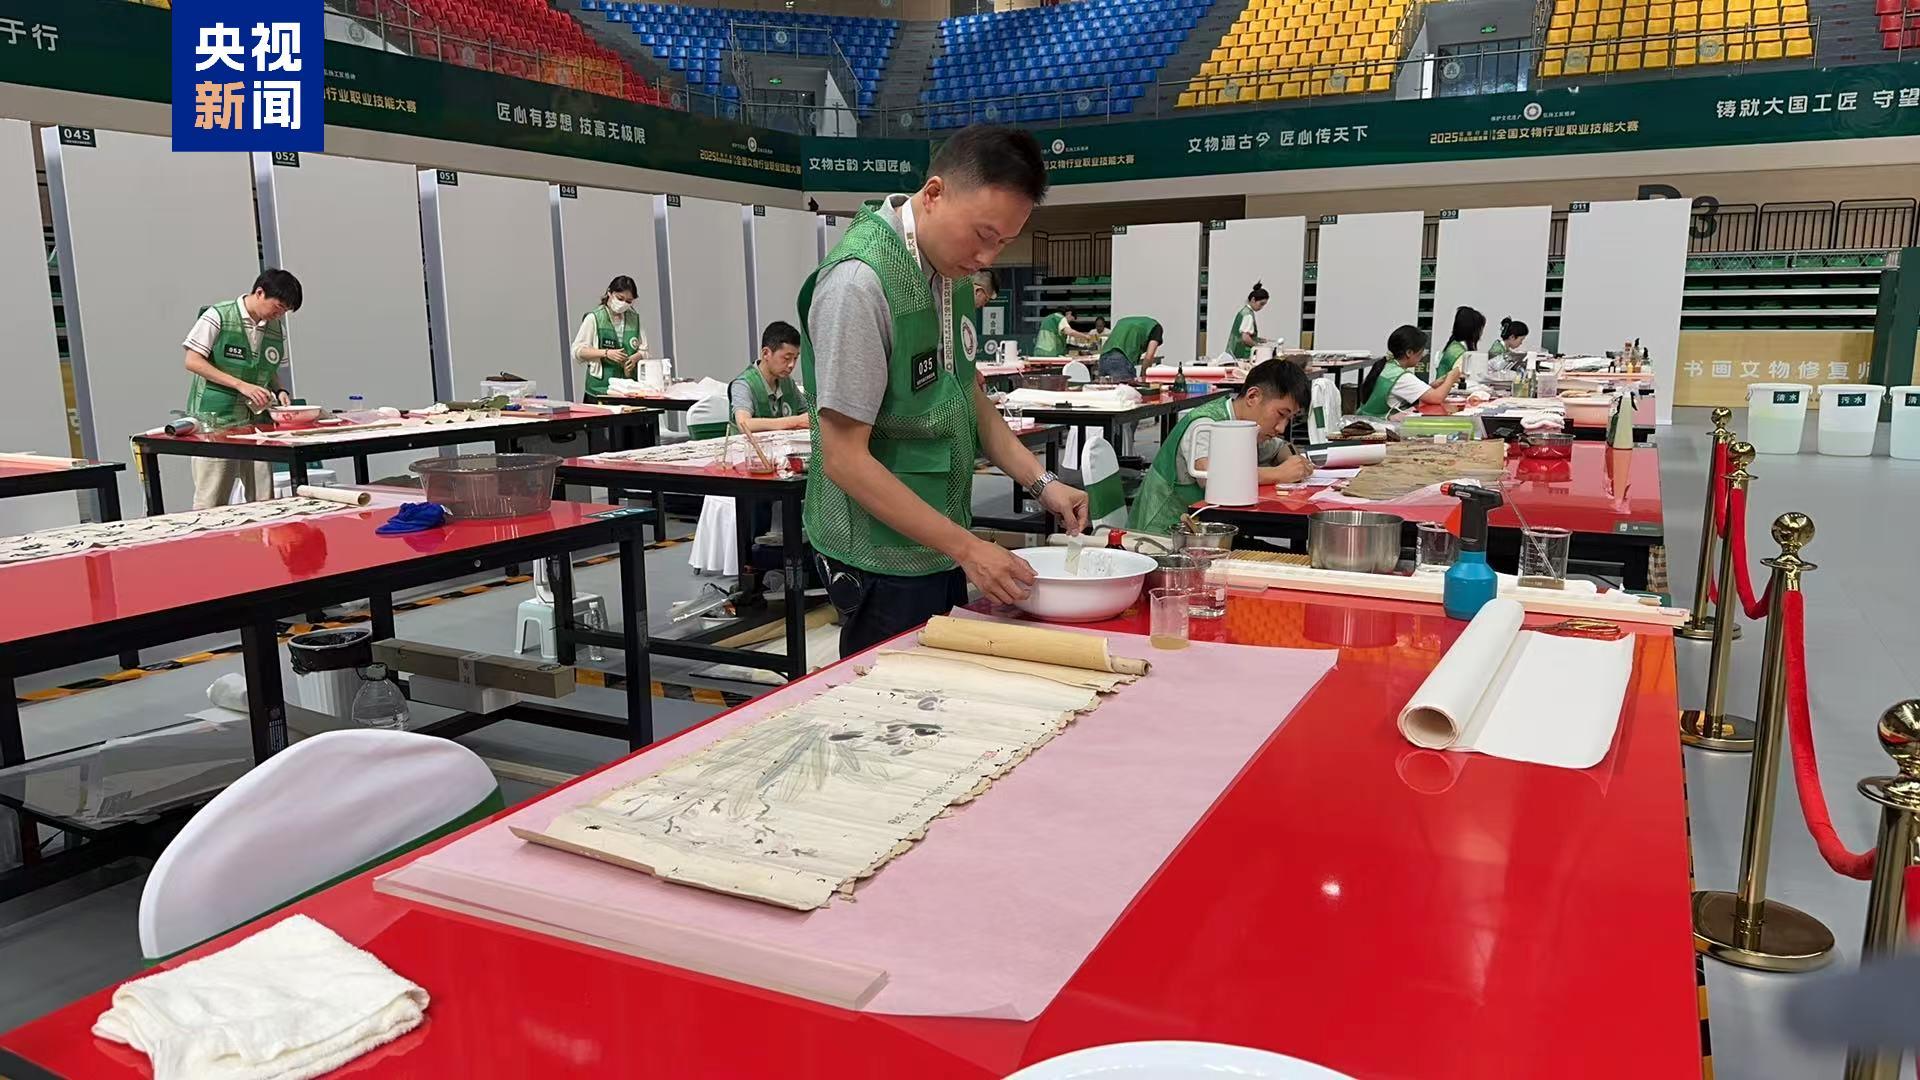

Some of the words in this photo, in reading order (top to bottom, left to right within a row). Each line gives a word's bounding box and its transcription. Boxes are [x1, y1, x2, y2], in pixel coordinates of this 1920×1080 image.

[0, 18, 59, 52] 于行
[324, 86, 417, 114] 行业职业技能大赛
[1716, 91, 1857, 119] 铸就大国工匠
[1872, 87, 1920, 109] 守望
[496, 101, 574, 132] 匠心有梦想
[579, 116, 647, 145] 技高无极限
[1430, 132, 1458, 144] 2025
[1497, 120, 1639, 140] 全国文物行业职业技能大赛
[64, 128, 90, 141] 045
[1188, 134, 1271, 154] 文物通古今
[1279, 125, 1370, 147] 匠心传天下
[275, 152, 296, 162] 052
[809, 157, 859, 172] 文物古韵
[862, 159, 911, 174] 大国匠心
[439, 171, 455, 181] 051
[561, 186, 575, 194] 046
[918, 357, 933, 375] 035
